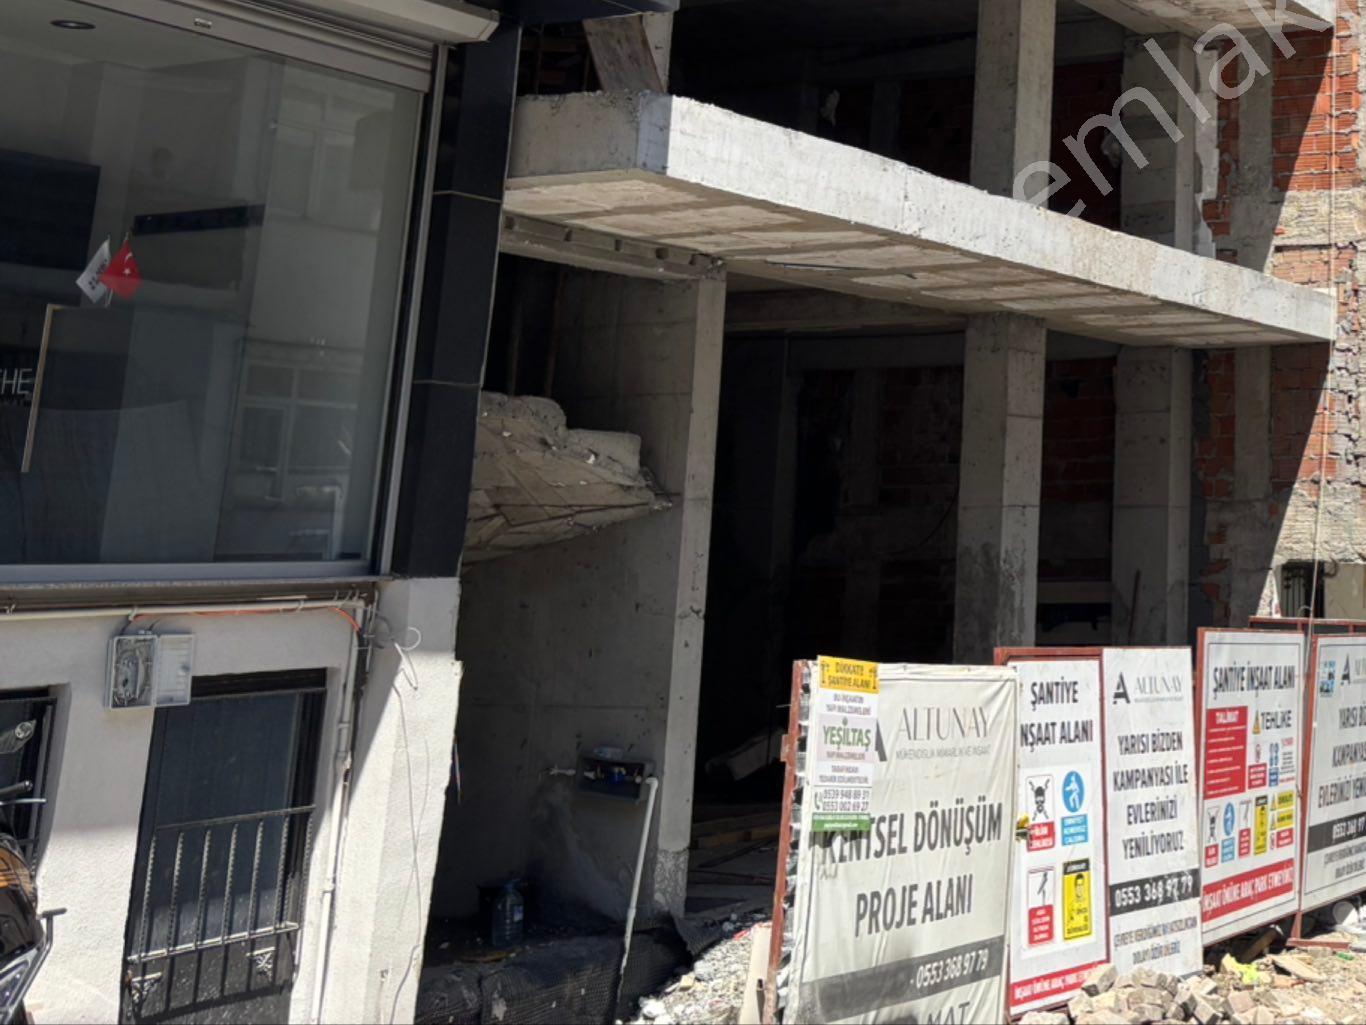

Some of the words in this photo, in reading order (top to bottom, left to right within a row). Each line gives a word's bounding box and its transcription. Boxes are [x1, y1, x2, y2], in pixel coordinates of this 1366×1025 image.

[0, 367, 33, 394] HE
[1030, 676, 1079, 711] ŞANTİYE
[1213, 661, 1245, 700] ŞANTİYE
[1247, 660, 1273, 698] İNŞAAT
[1273, 665, 1295, 689] ALANI
[900, 707, 990, 741] ALTUNAY
[1260, 705, 1292, 730] TEHLİKE
[823, 721, 871, 751] YEŞİLTAŞ
[1020, 722, 1056, 753] NŞAAT
[1059, 720, 1094, 742] ALANI
[1118, 734, 1150, 755] YARISI
[1151, 728, 1183, 752] BİZDEN
[1113, 765, 1173, 791] KAMPANYASI
[1175, 761, 1188, 784] İLE
[1126, 795, 1178, 825] EVLERİNİZİ
[914, 796, 1003, 855] DÖNÜŞÜM
[1122, 830, 1184, 860] YENİLİYORUZ
[855, 884, 918, 937] PROJE
[921, 874, 973, 923] ALANI
[1114, 885, 1141, 908] 0553
[916, 964, 943, 988] 0553
